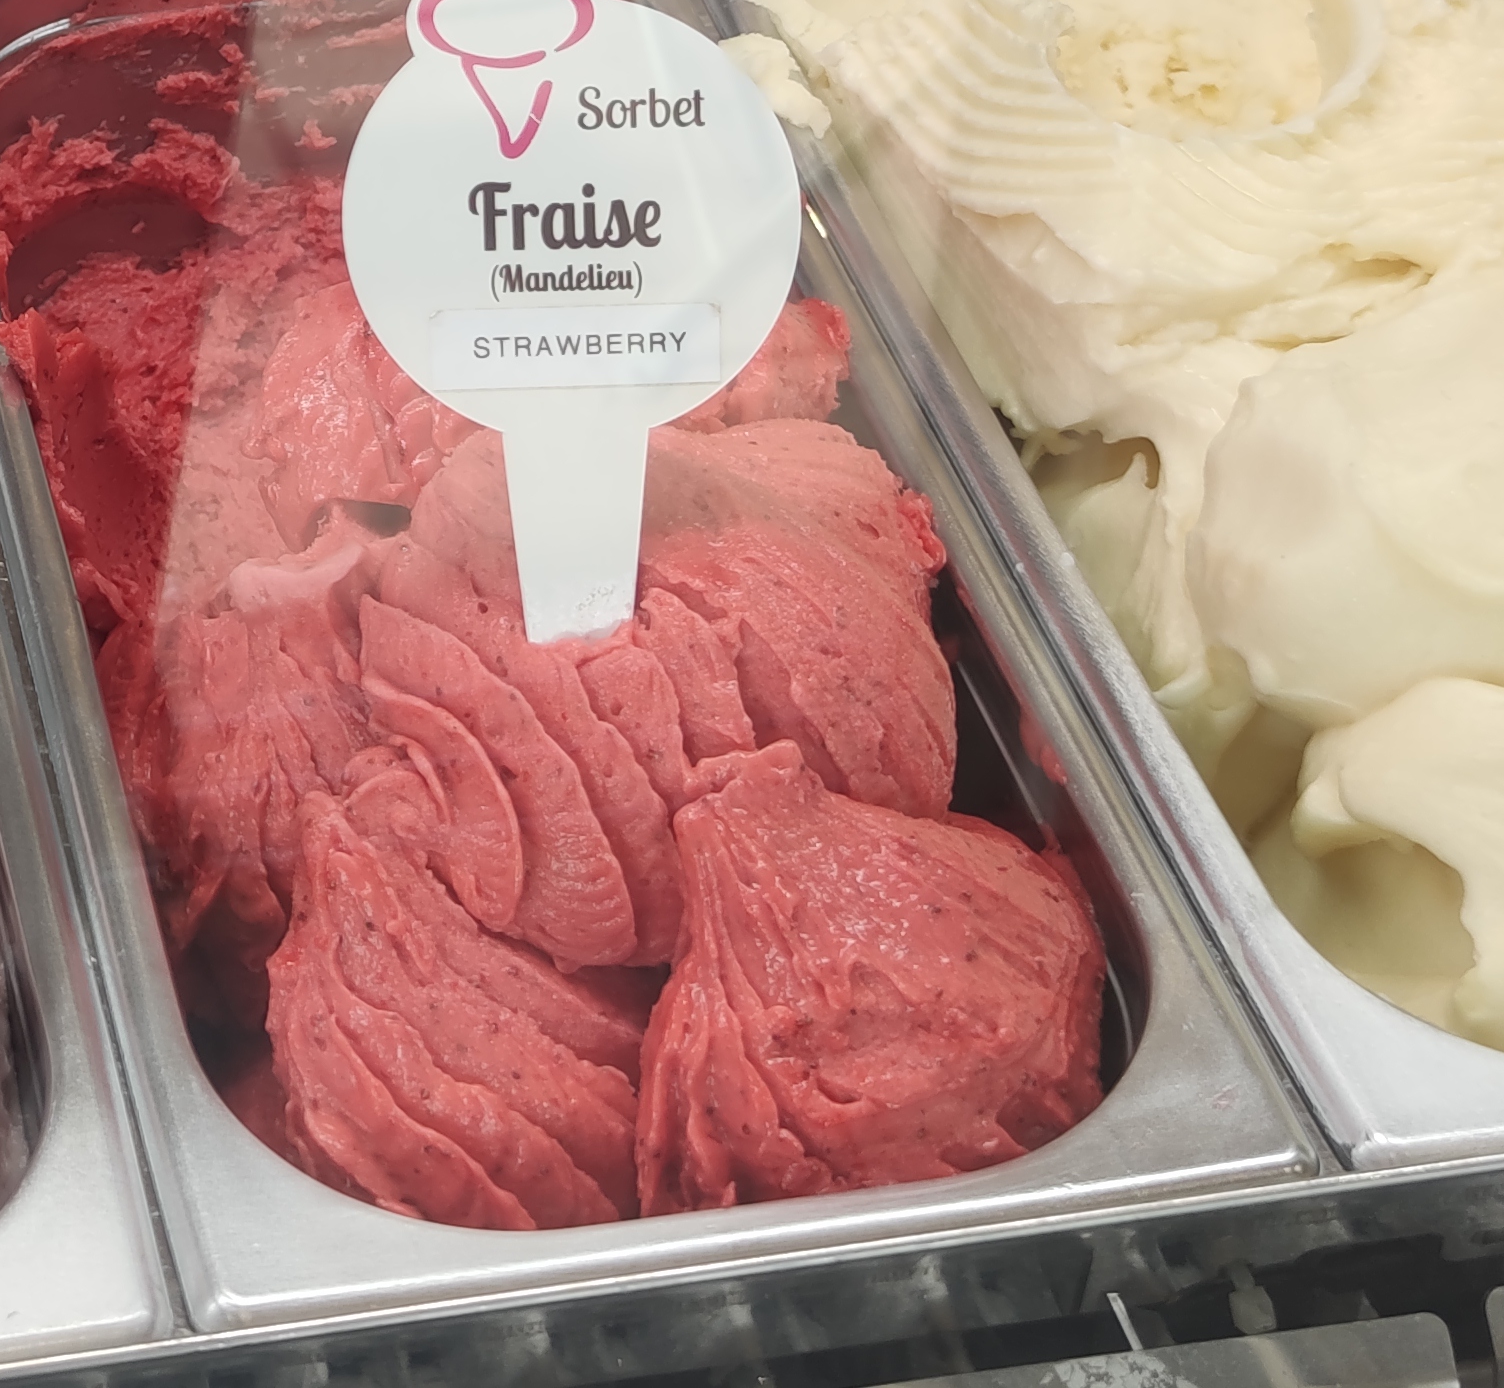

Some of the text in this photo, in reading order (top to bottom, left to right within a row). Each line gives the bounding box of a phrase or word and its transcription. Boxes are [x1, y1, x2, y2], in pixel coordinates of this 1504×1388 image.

[576, 85, 705, 131] Sorbet
[468, 181, 662, 252] Fraise
[490, 261, 643, 303] (Mandelieu)
[473, 331, 688, 359] STRAWBERRY
